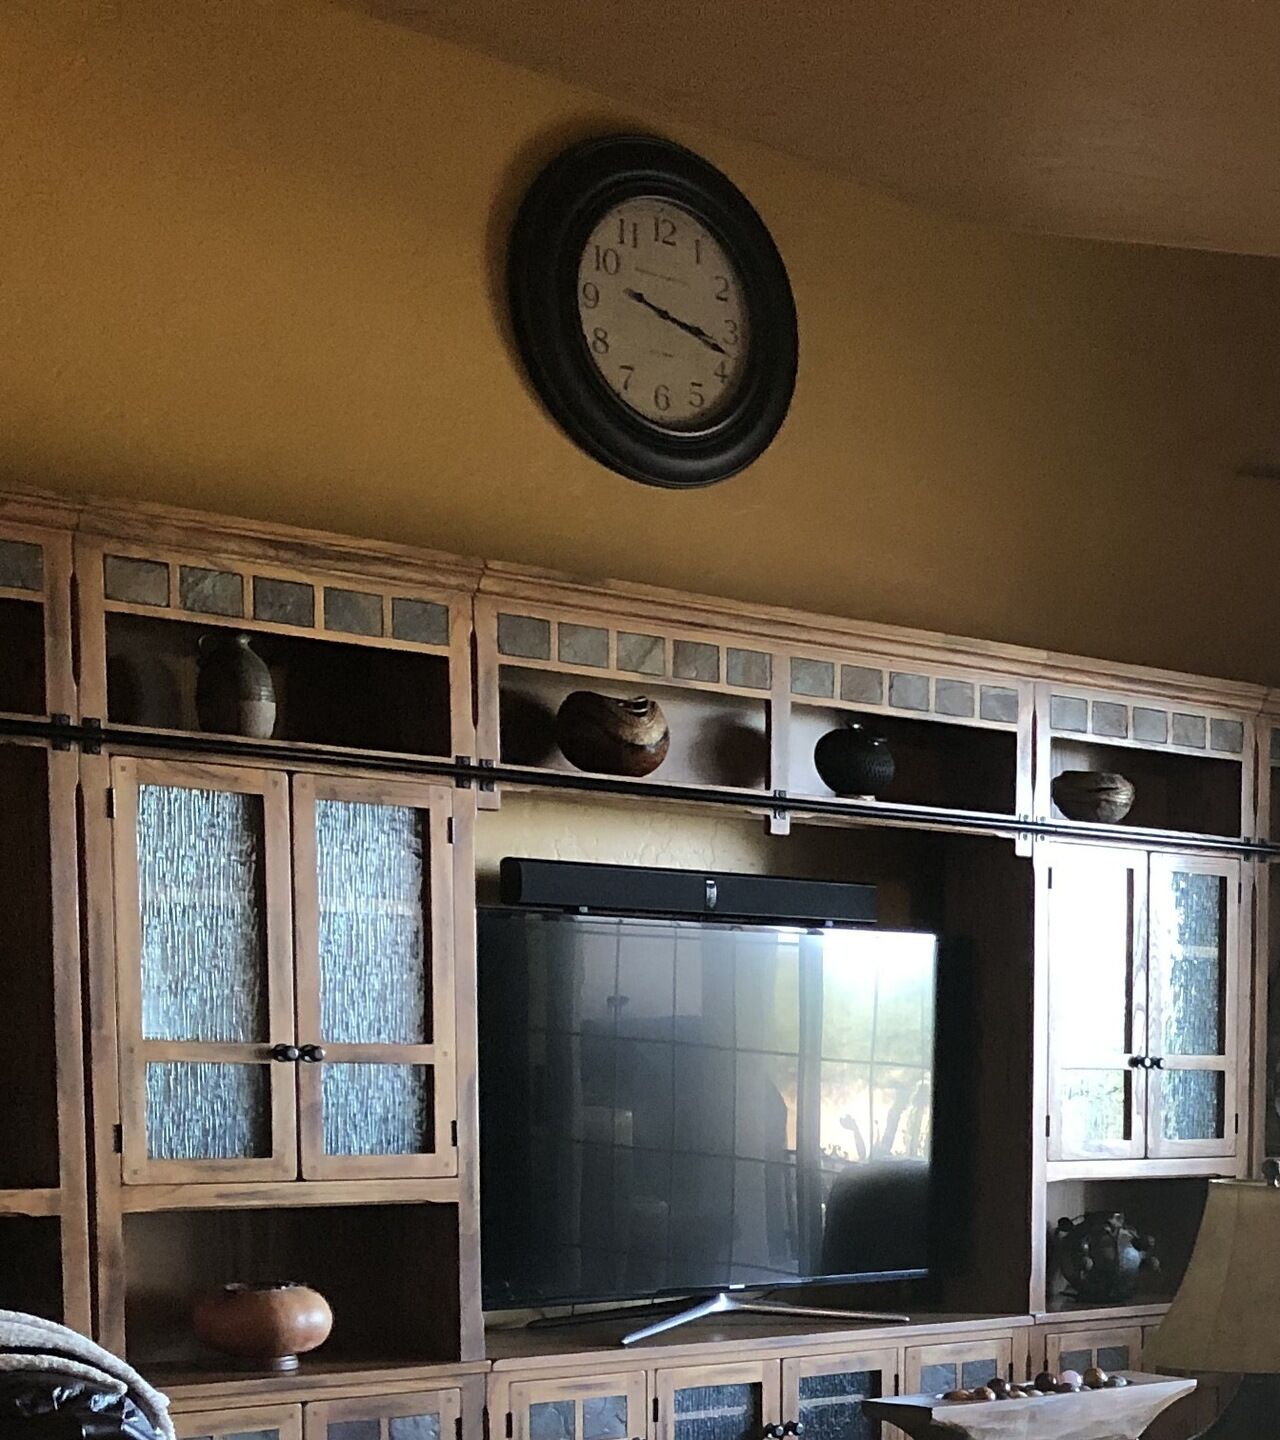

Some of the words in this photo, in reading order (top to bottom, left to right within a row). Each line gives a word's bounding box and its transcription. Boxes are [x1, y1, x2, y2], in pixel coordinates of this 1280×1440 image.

[617, 217, 639, 248] 11
[653, 216, 677, 246] 12
[594, 245, 621, 276] 10
[694, 240, 702, 265] 1
[583, 281, 600, 309] 9
[714, 275, 729, 302] 2
[593, 327, 610, 355] 8
[723, 319, 739, 346] 3
[619, 365, 635, 392] 7
[713, 361, 729, 384] 4
[654, 384, 671, 411] 6
[689, 382, 705, 408] 5
